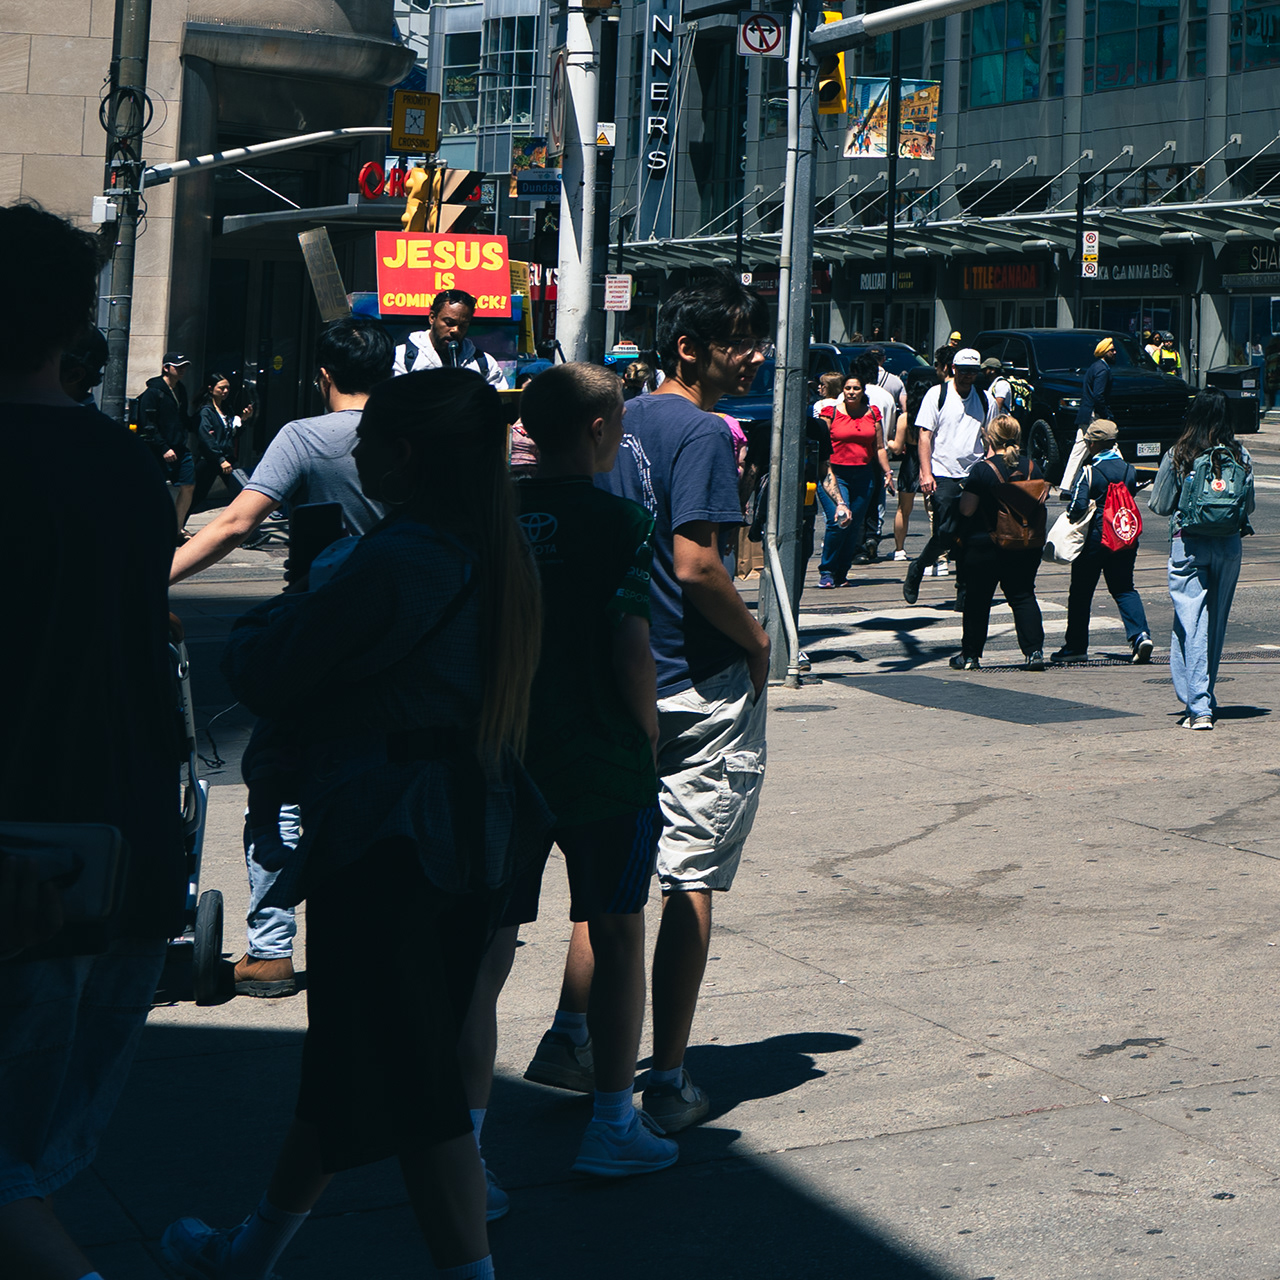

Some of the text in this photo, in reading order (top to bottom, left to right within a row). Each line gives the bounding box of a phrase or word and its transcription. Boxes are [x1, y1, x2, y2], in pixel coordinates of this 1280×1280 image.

[402, 94, 431, 107] PRIORITY
[398, 137, 430, 149] CROSSING
[522, 182, 559, 193] Dundas
[383, 239, 504, 271] JESUS
[994, 265, 1036, 289] CANADA
[1112, 263, 1173, 280] CANNABIS
[435, 272, 455, 290] IS
[383, 293, 507, 310] COMIN ACK!
